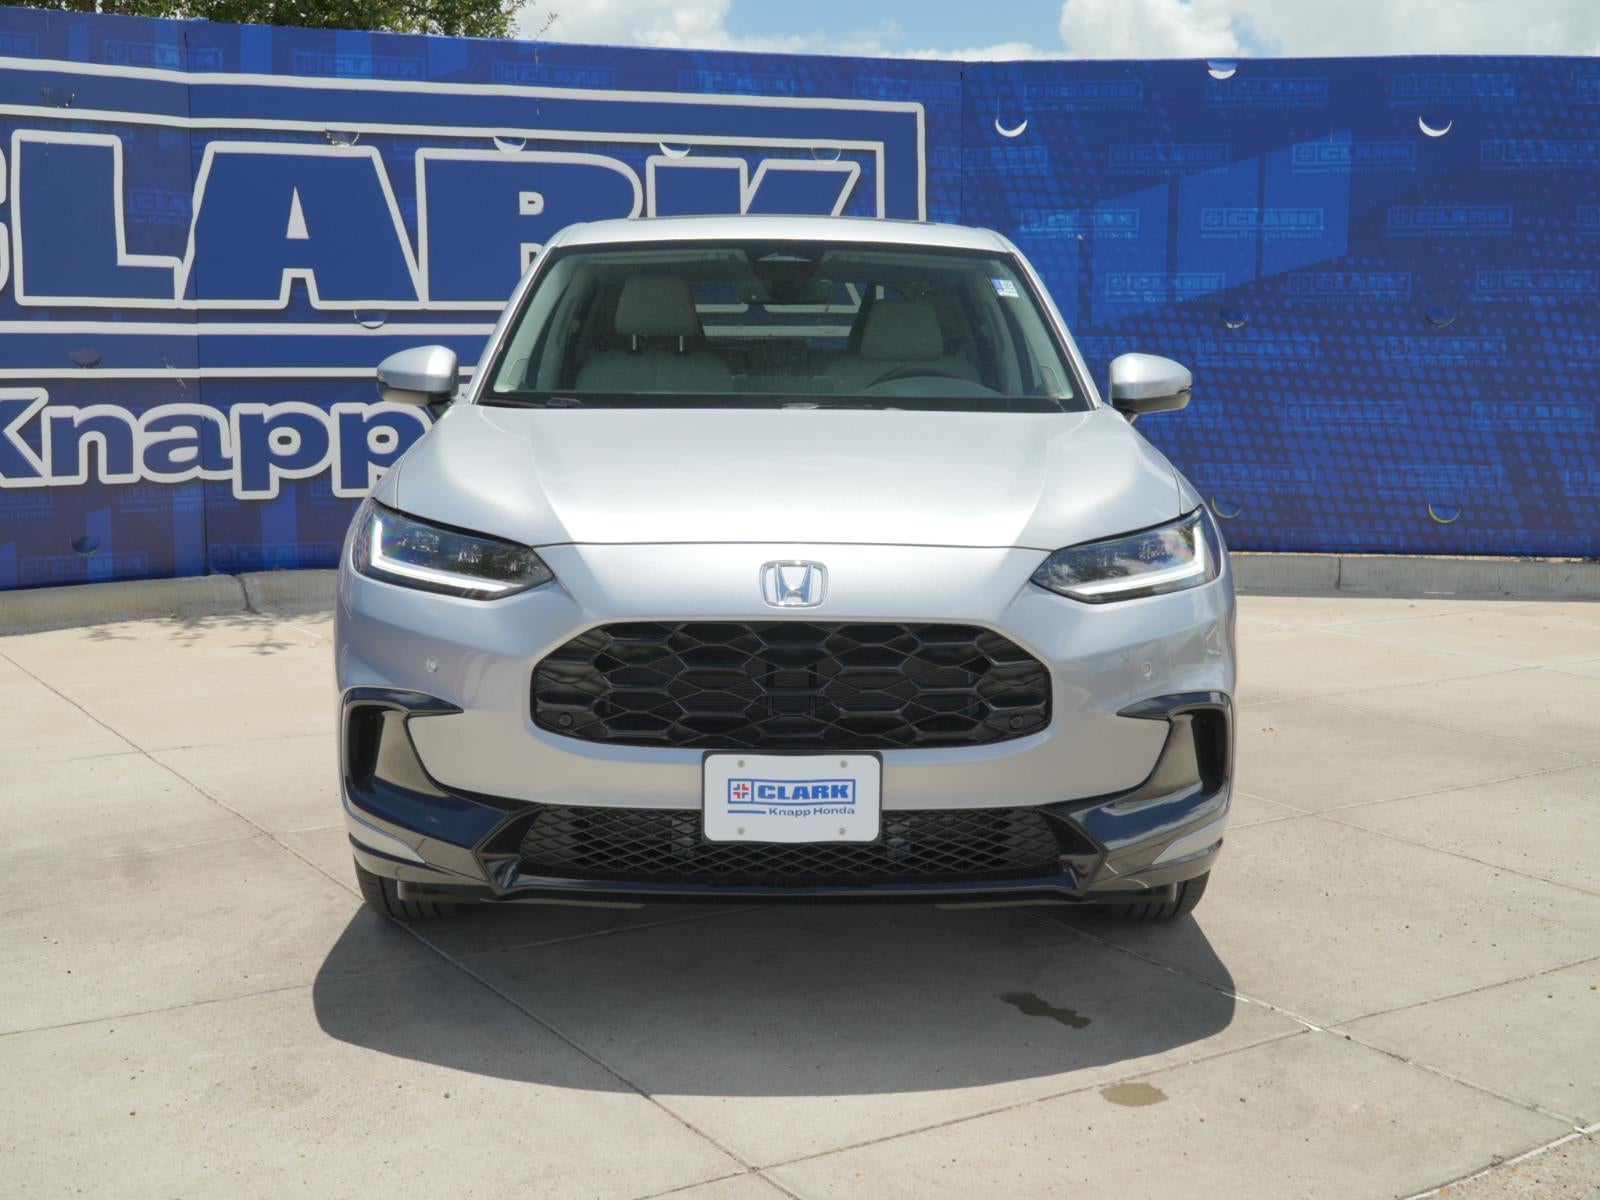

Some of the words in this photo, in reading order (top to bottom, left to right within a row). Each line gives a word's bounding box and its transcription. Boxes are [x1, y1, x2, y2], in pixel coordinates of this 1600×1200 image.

[0, 128, 861, 313] LAR
[1047, 213, 1134, 227] CLRK
[757, 784, 850, 800] CLARK
[768, 807, 812, 818] Knapp
[813, 806, 856, 816] Honda
